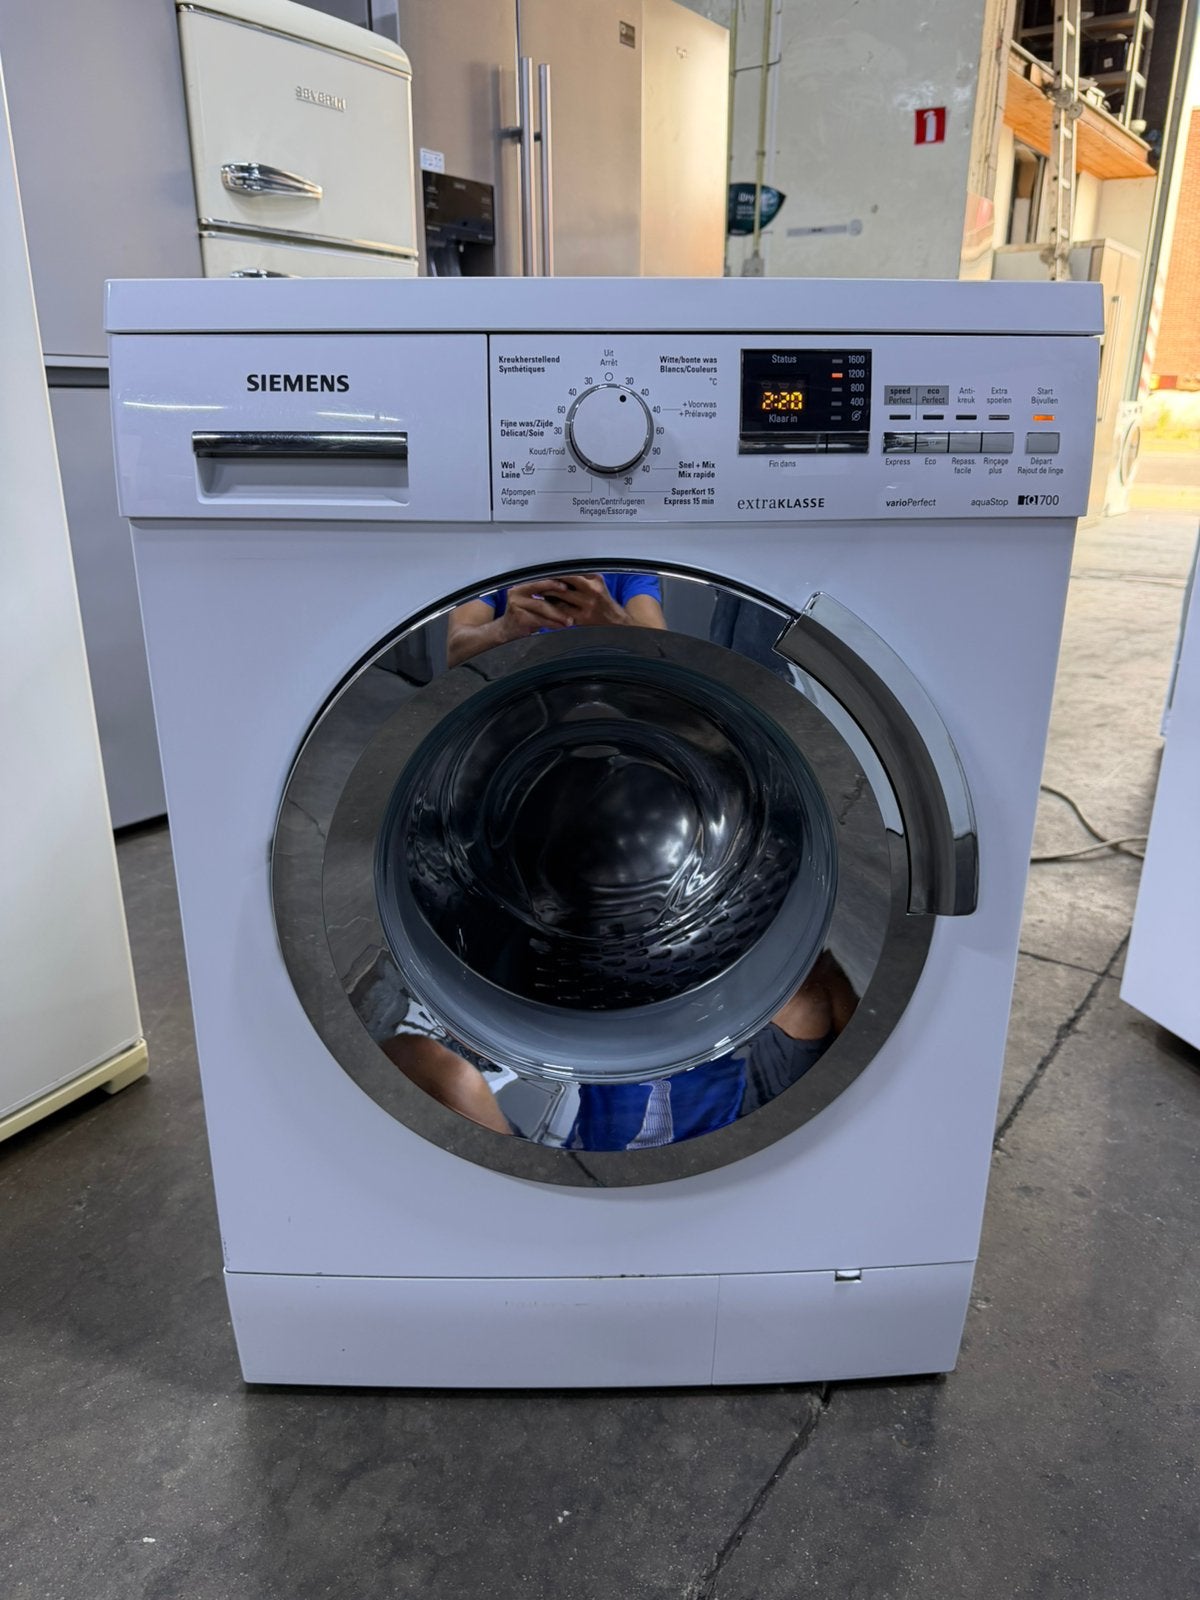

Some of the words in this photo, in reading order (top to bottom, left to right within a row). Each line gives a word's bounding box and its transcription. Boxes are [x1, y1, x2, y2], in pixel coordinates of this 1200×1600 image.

[498, 355, 561, 363] Kreukherstellend
[659, 355, 701, 364] Witte/bonte
[772, 354, 797, 364] Status
[848, 355, 865, 364] 1600
[498, 365, 546, 374] Synthétiques
[660, 365, 718, 373] Blancs/Couleurs
[848, 369, 865, 378] 1200
[246, 374, 350, 392] SIEMENS
[584, 377, 593, 385] 30
[625, 377, 634, 385] 30
[568, 388, 577, 396] 40
[641, 388, 650, 397] 40
[850, 384, 864, 392] 800
[890, 387, 911, 396] speed
[991, 387, 1008, 395] Extra
[1037, 387, 1054, 395] Start
[762, 391, 803, 410] 2:20
[850, 398, 864, 406] 400
[889, 396, 912, 404] Perfect
[922, 396, 945, 404] Perfect
[557, 405, 566, 414] 60
[652, 405, 661, 414] 40
[768, 414, 789, 423] Klaar
[790, 414, 798, 423] in
[500, 420, 517, 428] Fijne
[519, 420, 554, 428] was/Zijde
[500, 429, 545, 437] Délicat/Soie
[553, 427, 562, 435] 30
[655, 426, 665, 435] 60
[529, 447, 566, 456] Koud/Froid
[652, 447, 661, 455] 90
[501, 461, 516, 469] Wol
[678, 461, 695, 469] Snel
[702, 461, 716, 469] Mix
[768, 459, 778, 468] Fin
[779, 459, 796, 468] dans
[885, 457, 911, 466] Express
[924, 457, 937, 465] Eco
[983, 457, 1009, 466] Rinçage
[1030, 457, 1052, 466] Départ
[567, 465, 577, 473] 30
[641, 464, 651, 473] 40
[988, 467, 1003, 475] plus
[1017, 466, 1038, 475] Rajout
[1039, 466, 1048, 474] de
[1048, 466, 1064, 475] linge
[501, 471, 521, 479] Laine
[678, 470, 692, 478] Mix
[693, 470, 716, 480] rapide
[624, 477, 633, 485] 30
[501, 488, 536, 497] Afpompen
[671, 487, 706, 496] SuperKort
[501, 498, 529, 506] Vidange
[572, 497, 646, 507] Spoelen/Centrifugeren
[664, 497, 691, 506] Express
[737, 498, 825, 510] extraKLASSE
[886, 498, 937, 507] varioPerfect
[970, 498, 1009, 507] aquaStop
[580, 507, 638, 516] Rinçage/Essorage
